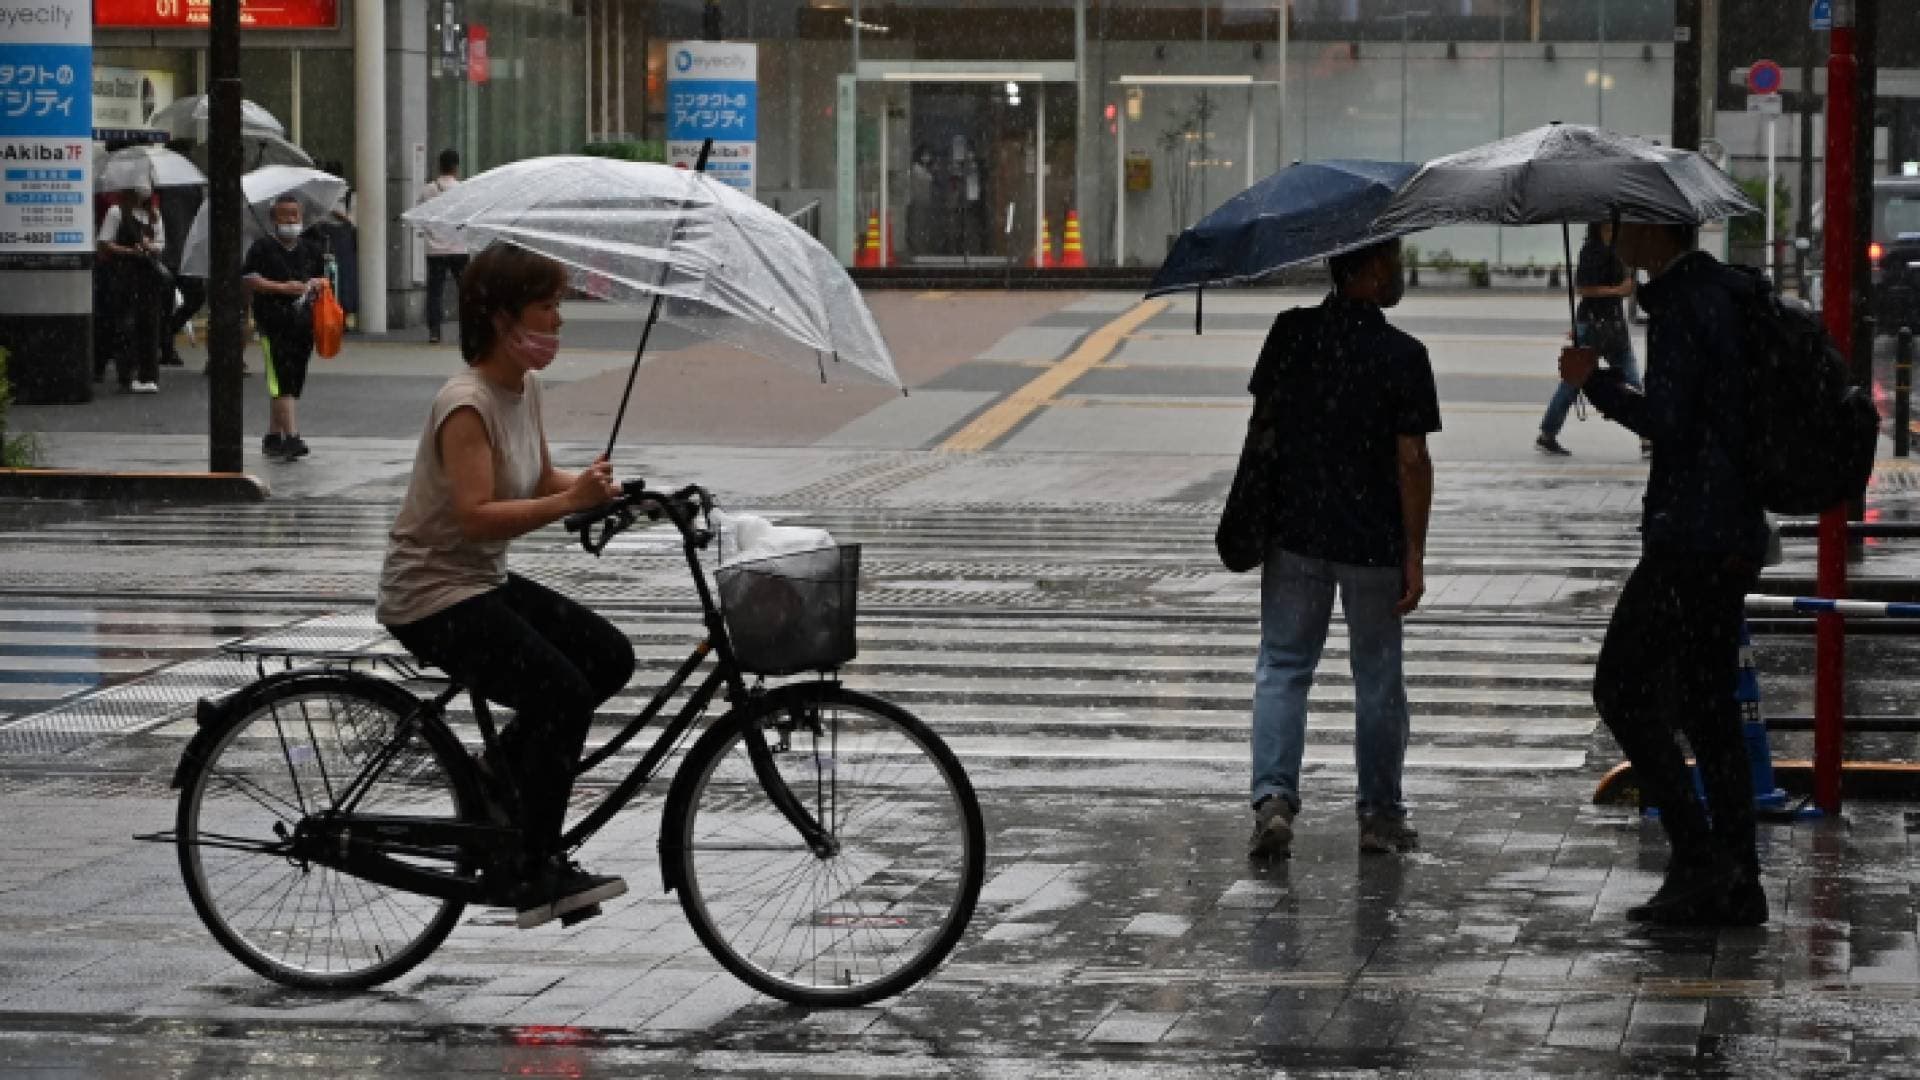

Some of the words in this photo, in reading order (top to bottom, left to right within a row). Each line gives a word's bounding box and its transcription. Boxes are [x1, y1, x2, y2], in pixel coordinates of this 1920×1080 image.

[694, 53, 747, 70] eyecity
[0, 88, 74, 117] シティ
[674, 94, 747, 108] コンタクトの
[674, 110, 747, 128] アイシティ
